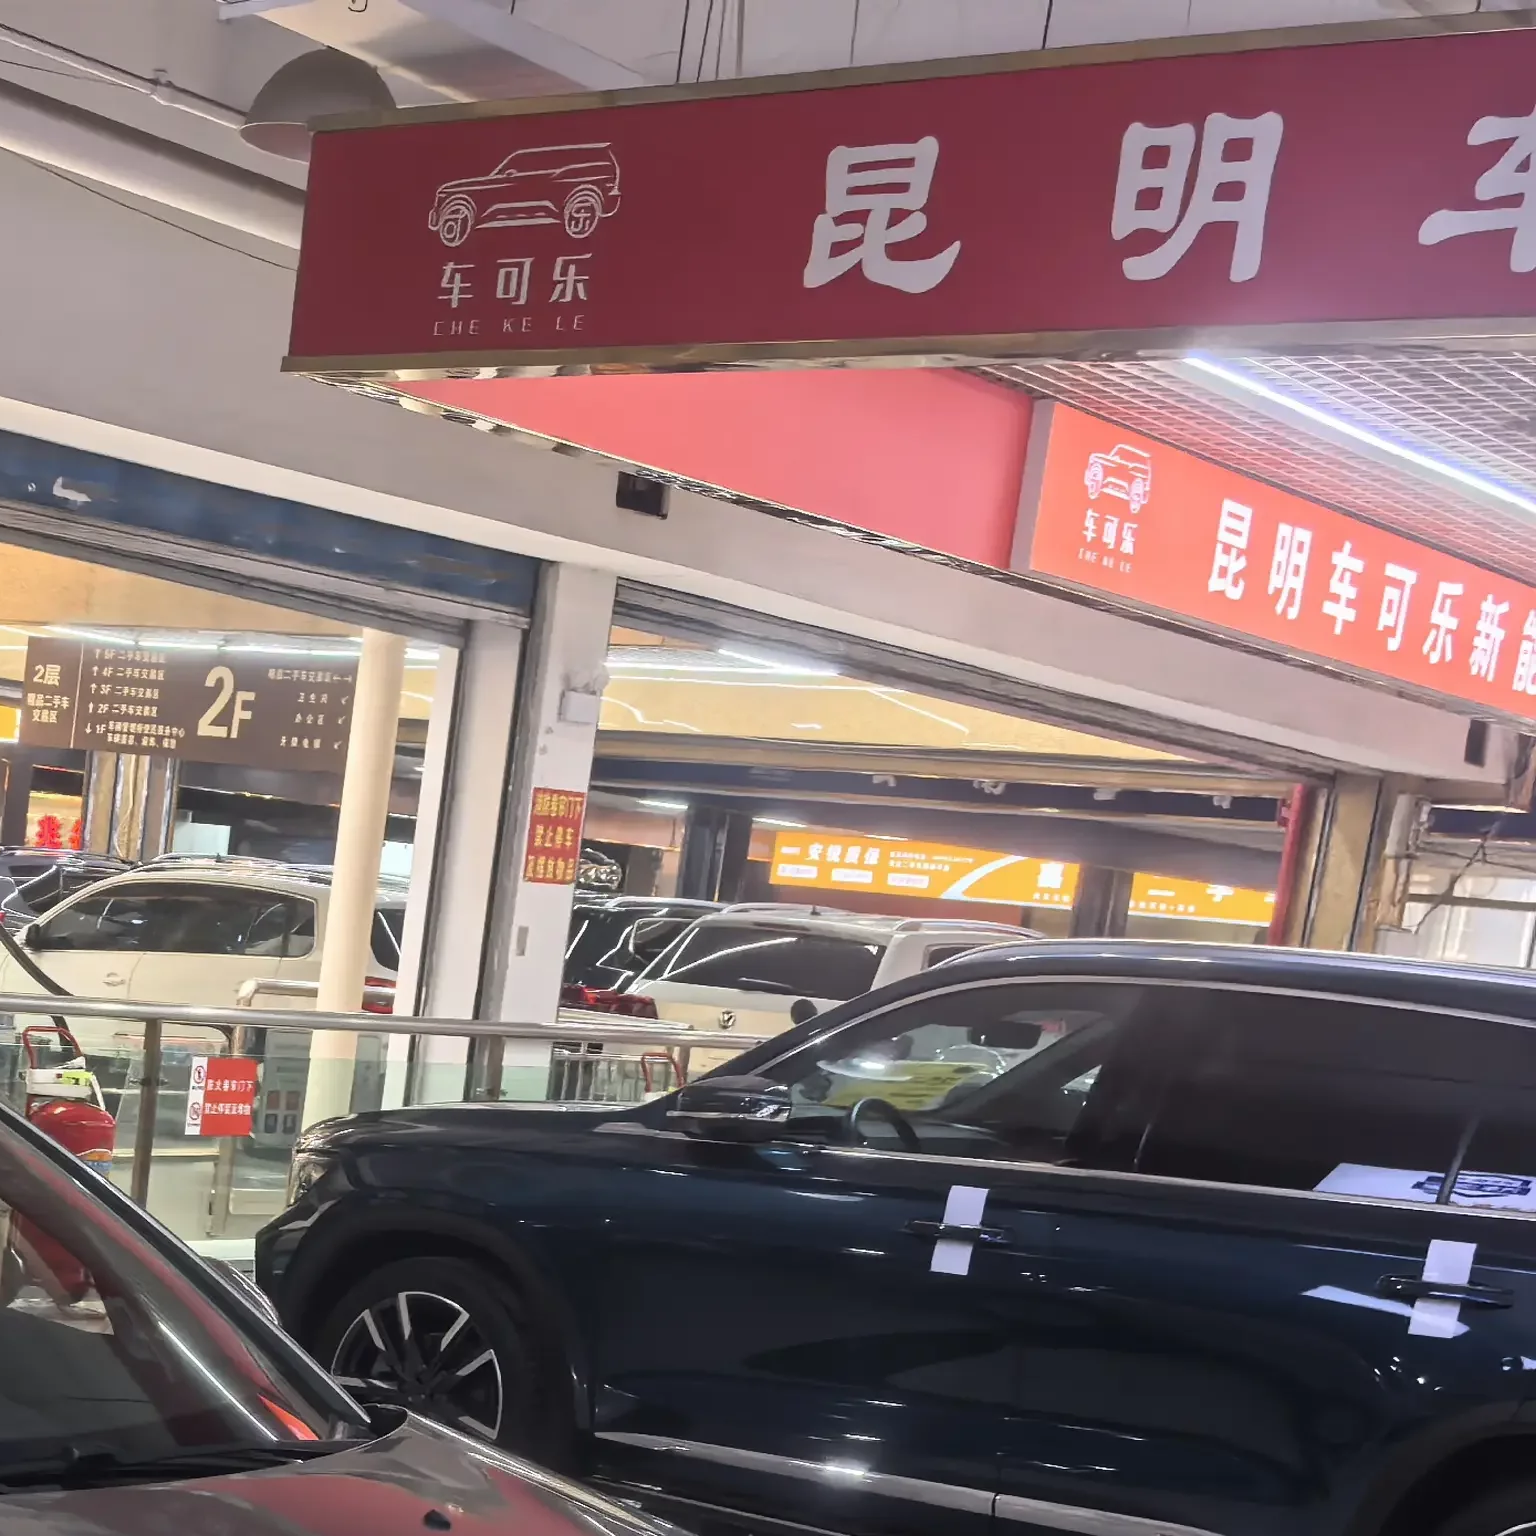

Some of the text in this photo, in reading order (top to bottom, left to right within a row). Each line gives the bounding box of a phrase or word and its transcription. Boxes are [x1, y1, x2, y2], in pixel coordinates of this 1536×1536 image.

[437, 253, 592, 308] 车可乐
[433, 314, 585, 336] CHE KE LE
[1082, 508, 1138, 555] 车可乐
[33, 664, 61, 688] 2层
[197, 666, 256, 739] 2F
